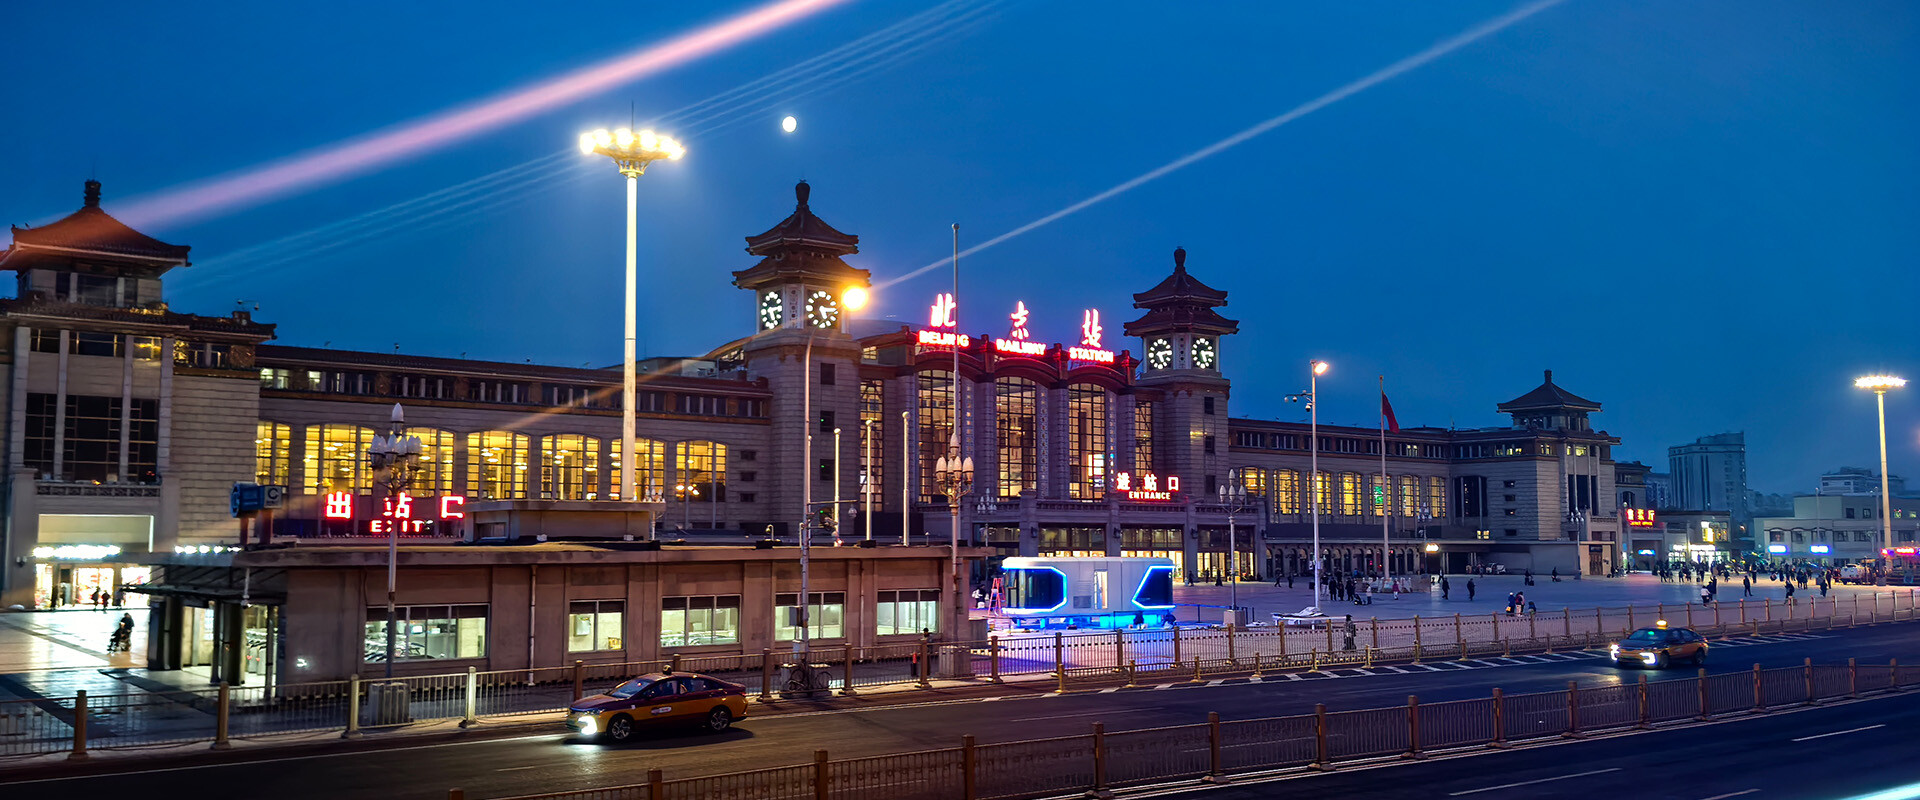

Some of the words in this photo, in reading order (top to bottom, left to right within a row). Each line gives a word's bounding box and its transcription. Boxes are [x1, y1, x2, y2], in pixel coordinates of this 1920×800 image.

[930, 293, 1102, 348] 北京站
[918, 330, 970, 347] BEIJING
[996, 338, 1047, 356] RAILWAY
[1069, 347, 1114, 363] STATION
[1116, 472, 1179, 491] 进站口
[1128, 491, 1171, 500] ENTRANCE
